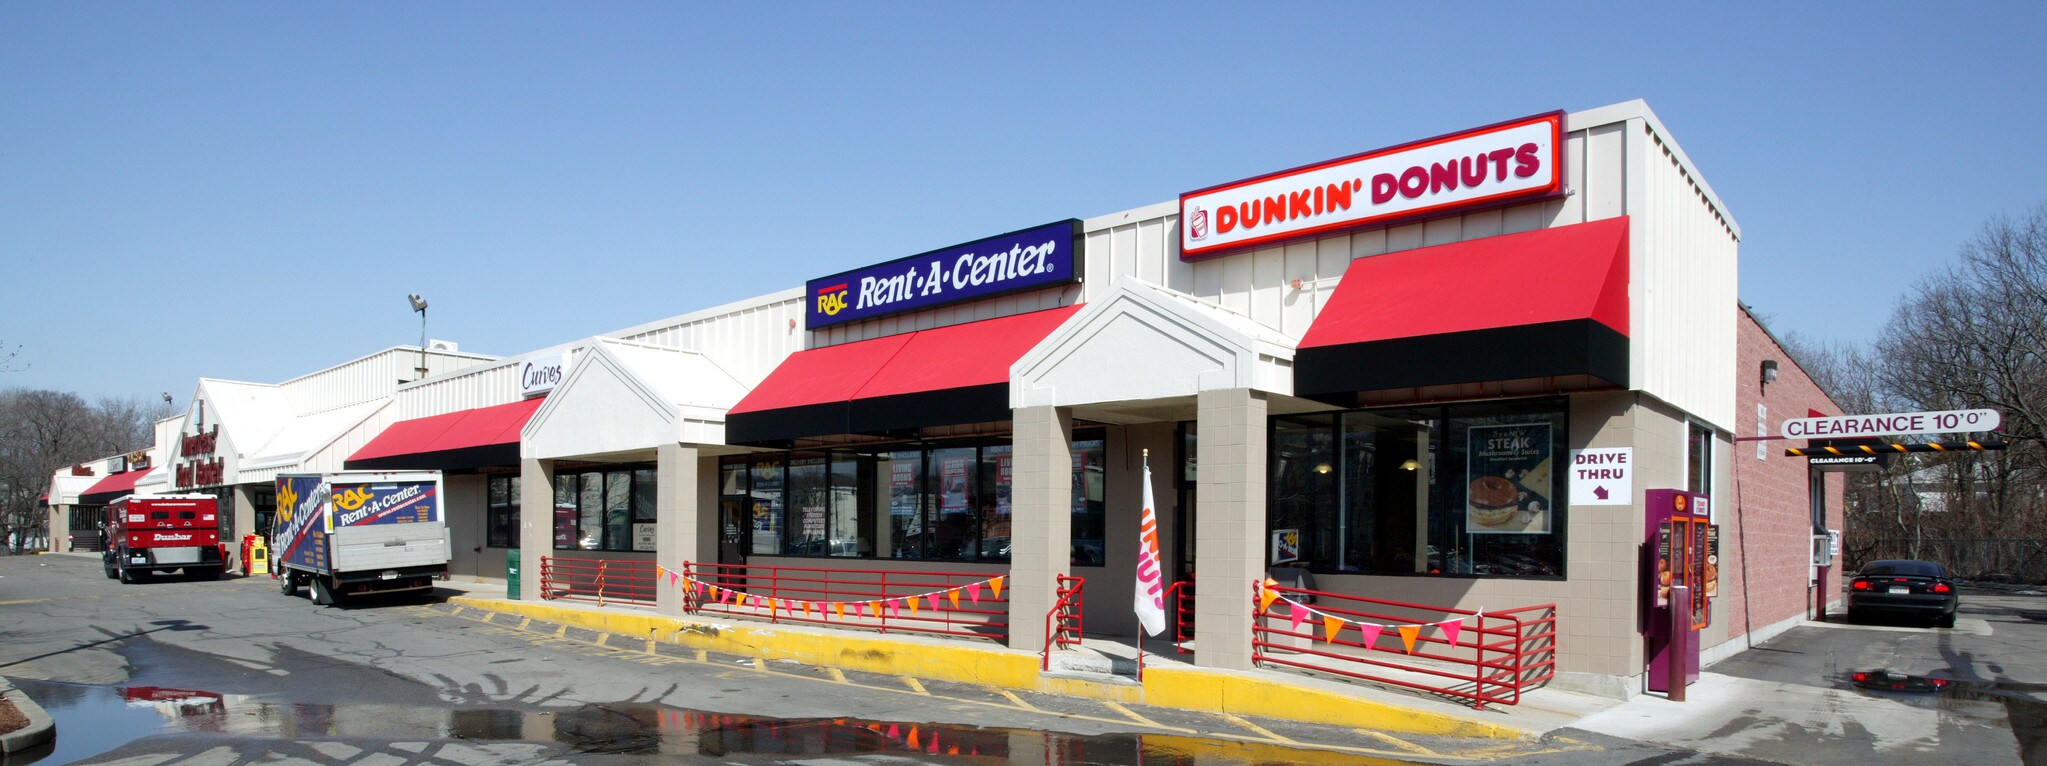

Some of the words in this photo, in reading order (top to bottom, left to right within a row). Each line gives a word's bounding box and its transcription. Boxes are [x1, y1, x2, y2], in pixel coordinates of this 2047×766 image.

[1216, 178, 1362, 233] DUNKIN'
[1371, 142, 1540, 205] DONUTS
[818, 290, 848, 316] RAC
[522, 361, 562, 390] Curves
[1787, 415, 1924, 436] CLEARANCE
[1488, 437, 1530, 450] STEAK
[1576, 453, 1627, 465] DRIVE
[893, 464, 912, 473] LIVING
[1577, 468, 1624, 480] THRU
[332, 484, 374, 512] RAC
[153, 533, 192, 541] Dunbar
